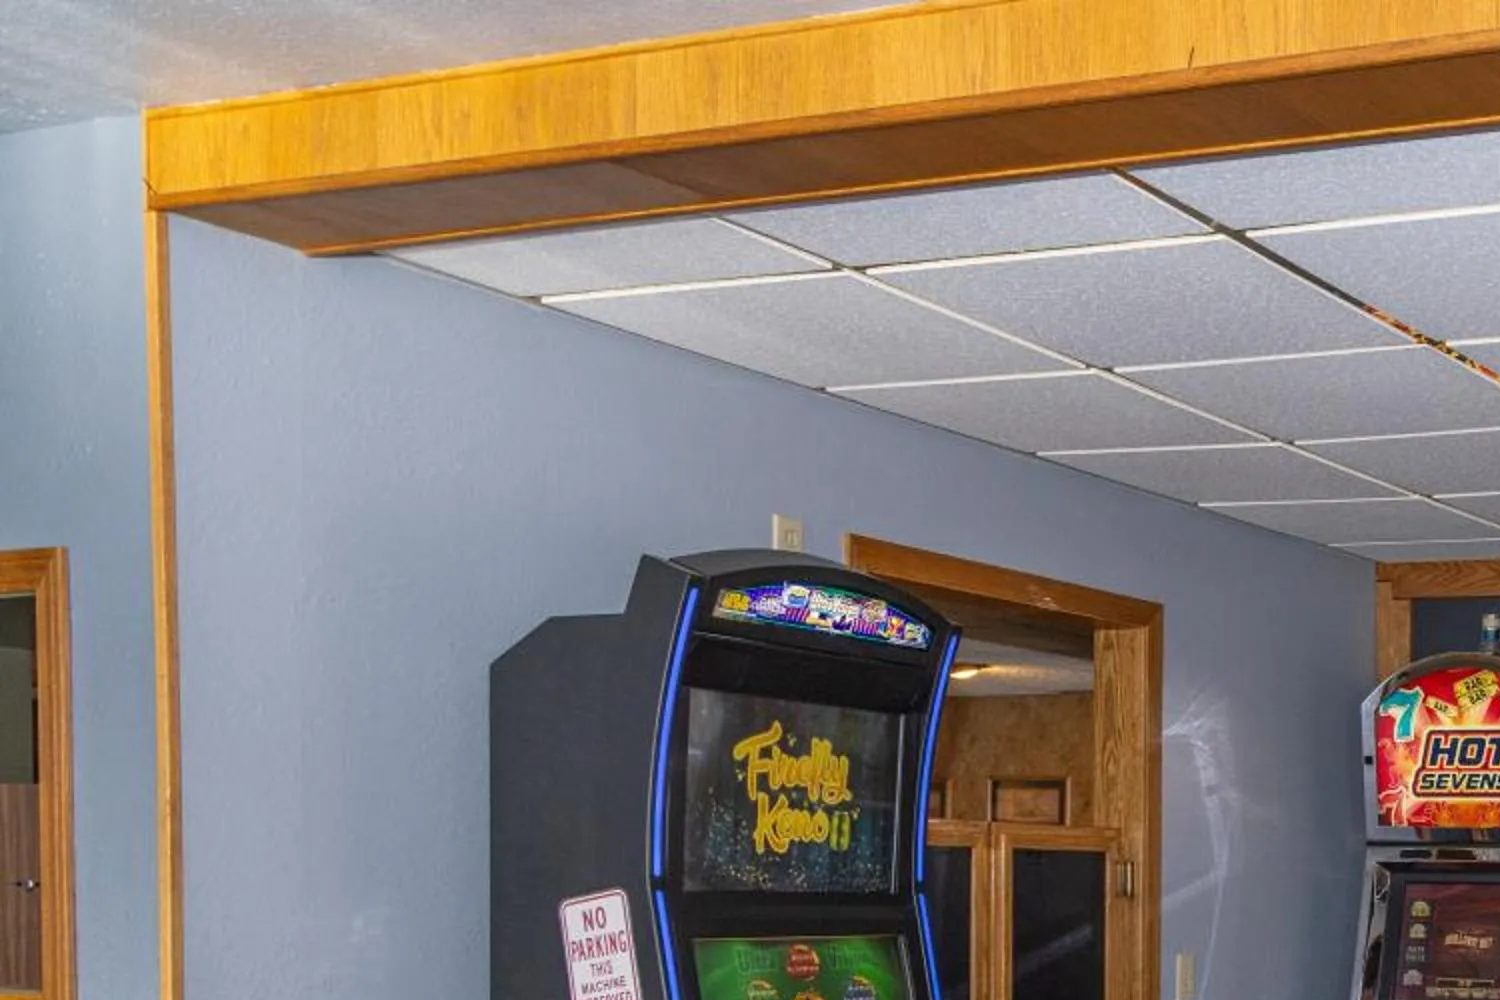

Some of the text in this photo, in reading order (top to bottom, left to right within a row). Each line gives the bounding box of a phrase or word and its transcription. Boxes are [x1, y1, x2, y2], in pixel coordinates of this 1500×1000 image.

[733, 720, 853, 804] Firefly
[753, 791, 830, 855] Keno
[582, 906, 607, 932] NO
[570, 930, 627, 961] PARKING
[590, 960, 613, 978] THIS
[581, 975, 627, 994] MACHINE
